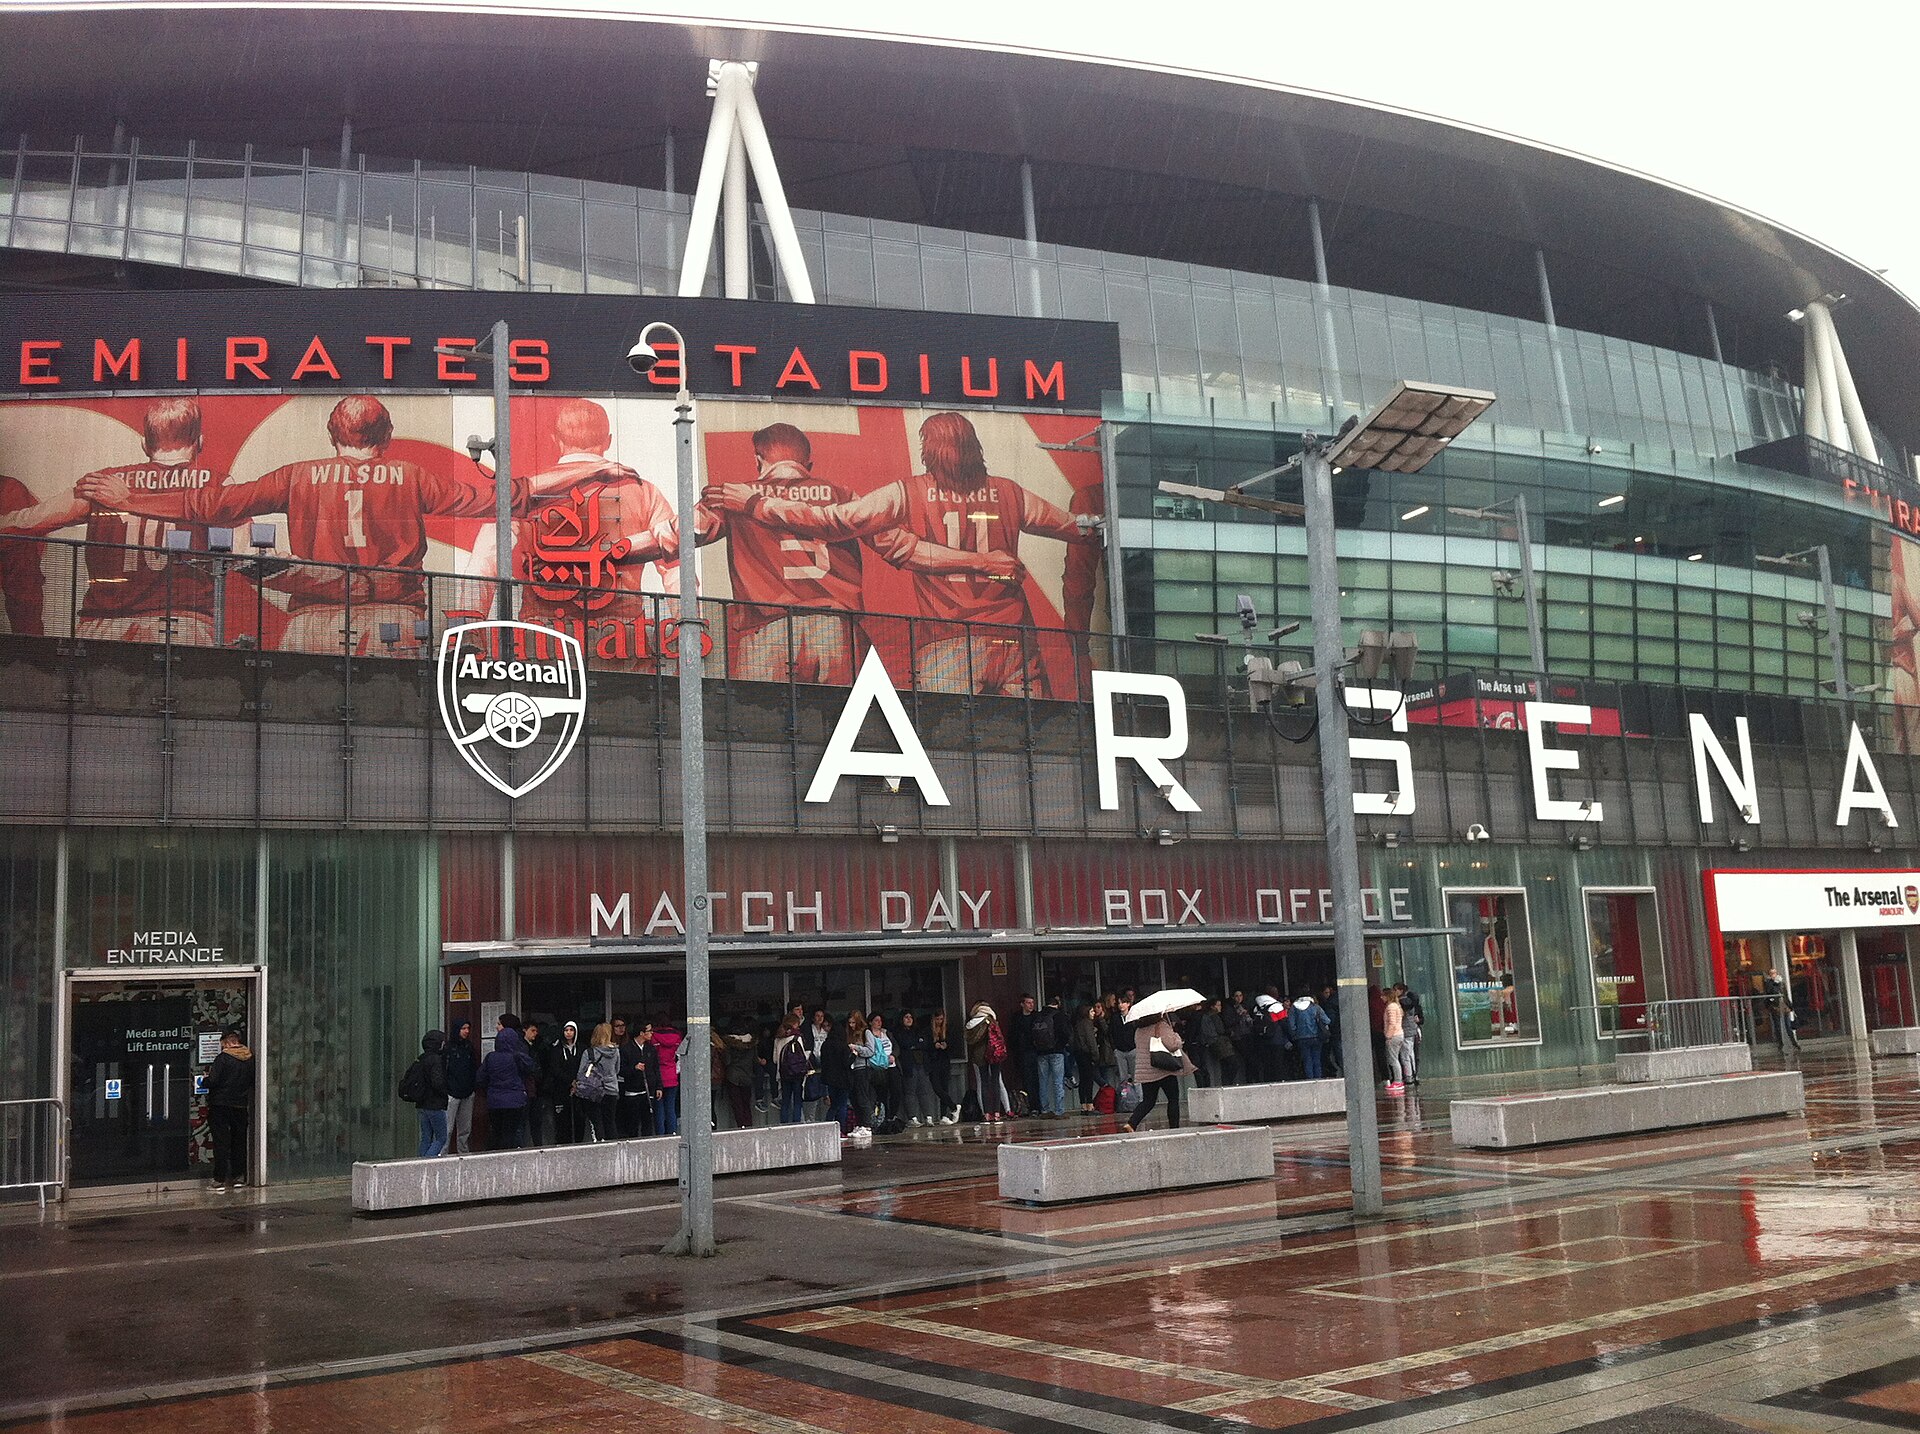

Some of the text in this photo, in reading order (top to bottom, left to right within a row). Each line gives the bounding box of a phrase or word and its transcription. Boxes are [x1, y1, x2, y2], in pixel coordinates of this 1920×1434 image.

[19, 335, 1066, 401] EMIRATES STADIUM
[311, 464, 404, 486] WILSON
[343, 489, 367, 548] 1
[459, 653, 567, 685] Arsenal
[1477, 679, 1492, 693] The
[1105, 887, 1413, 926] BOX OFFCE
[1824, 885, 1904, 907] The Arsenal
[589, 888, 992, 937] MATCH DAY
[133, 931, 198, 946] MEDIA
[106, 948, 224, 964] ENTRANCE
[126, 1027, 178, 1039] Media and
[127, 1042, 145, 1052] Lift
[146, 1041, 190, 1052] Entrance
